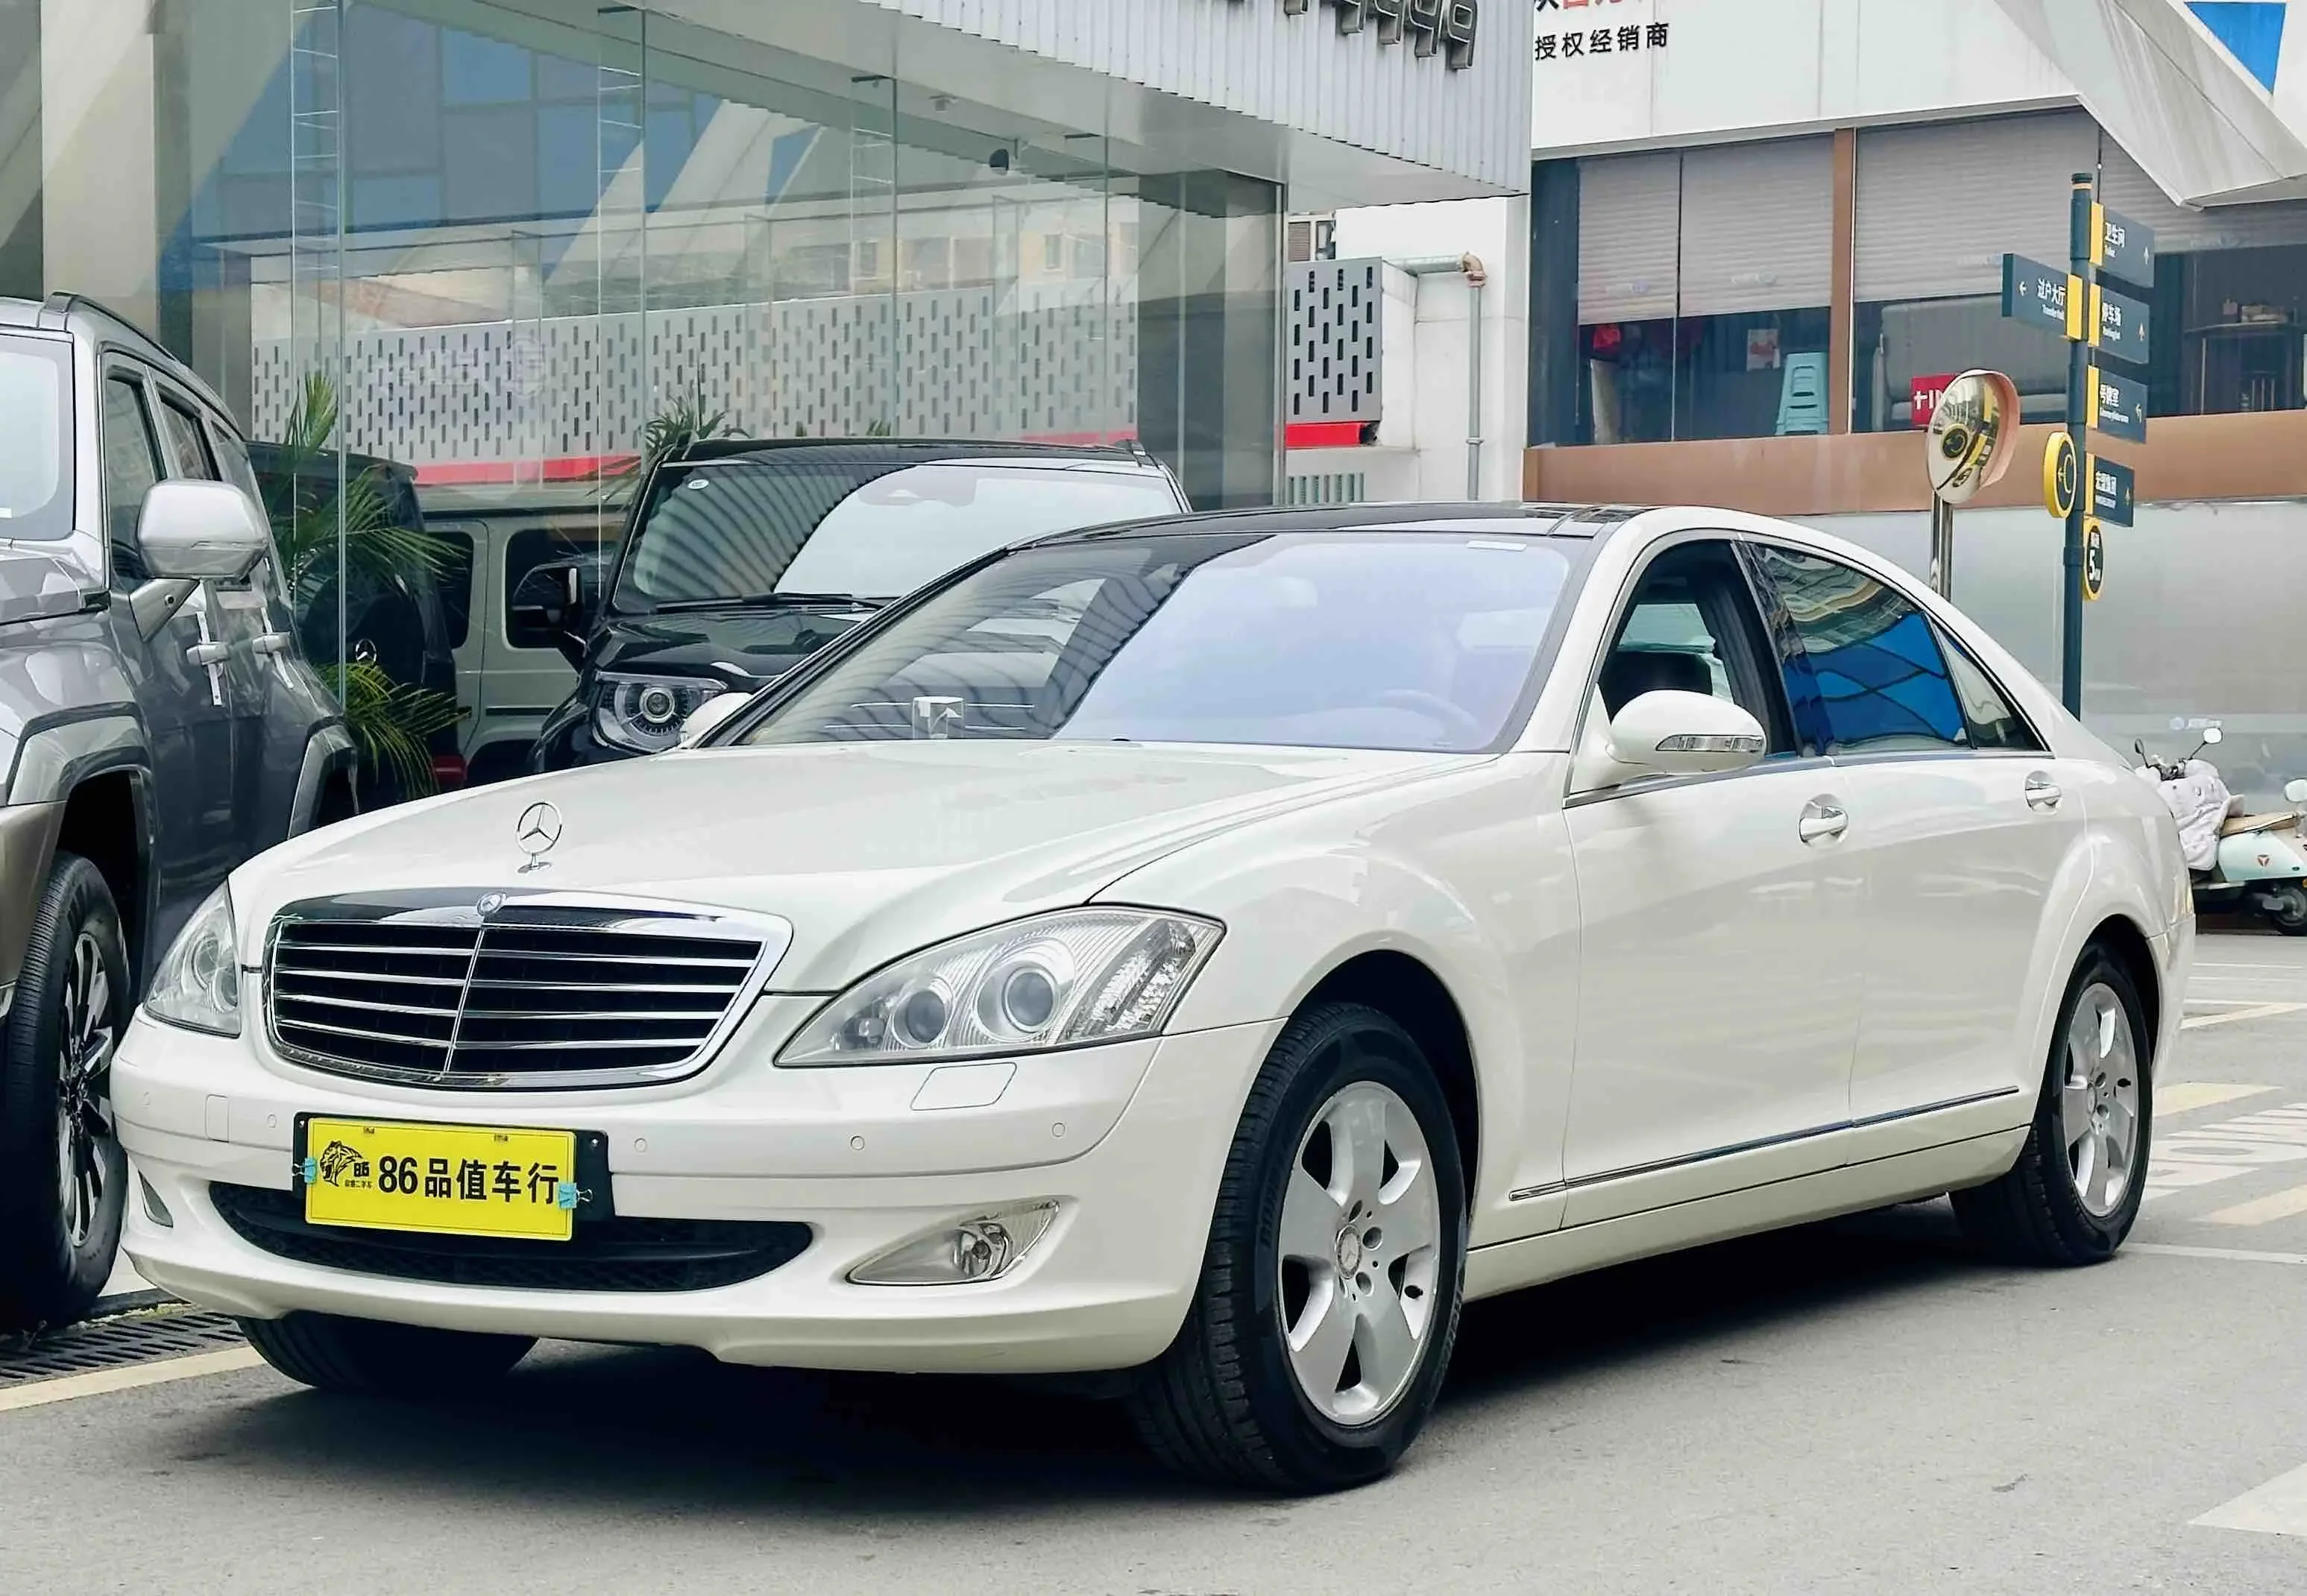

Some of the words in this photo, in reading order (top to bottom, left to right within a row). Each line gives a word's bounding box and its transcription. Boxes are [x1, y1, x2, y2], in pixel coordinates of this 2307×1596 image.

[1535, 22, 1669, 60] 授权经销商
[378, 1155, 558, 1205] 86品值车行
